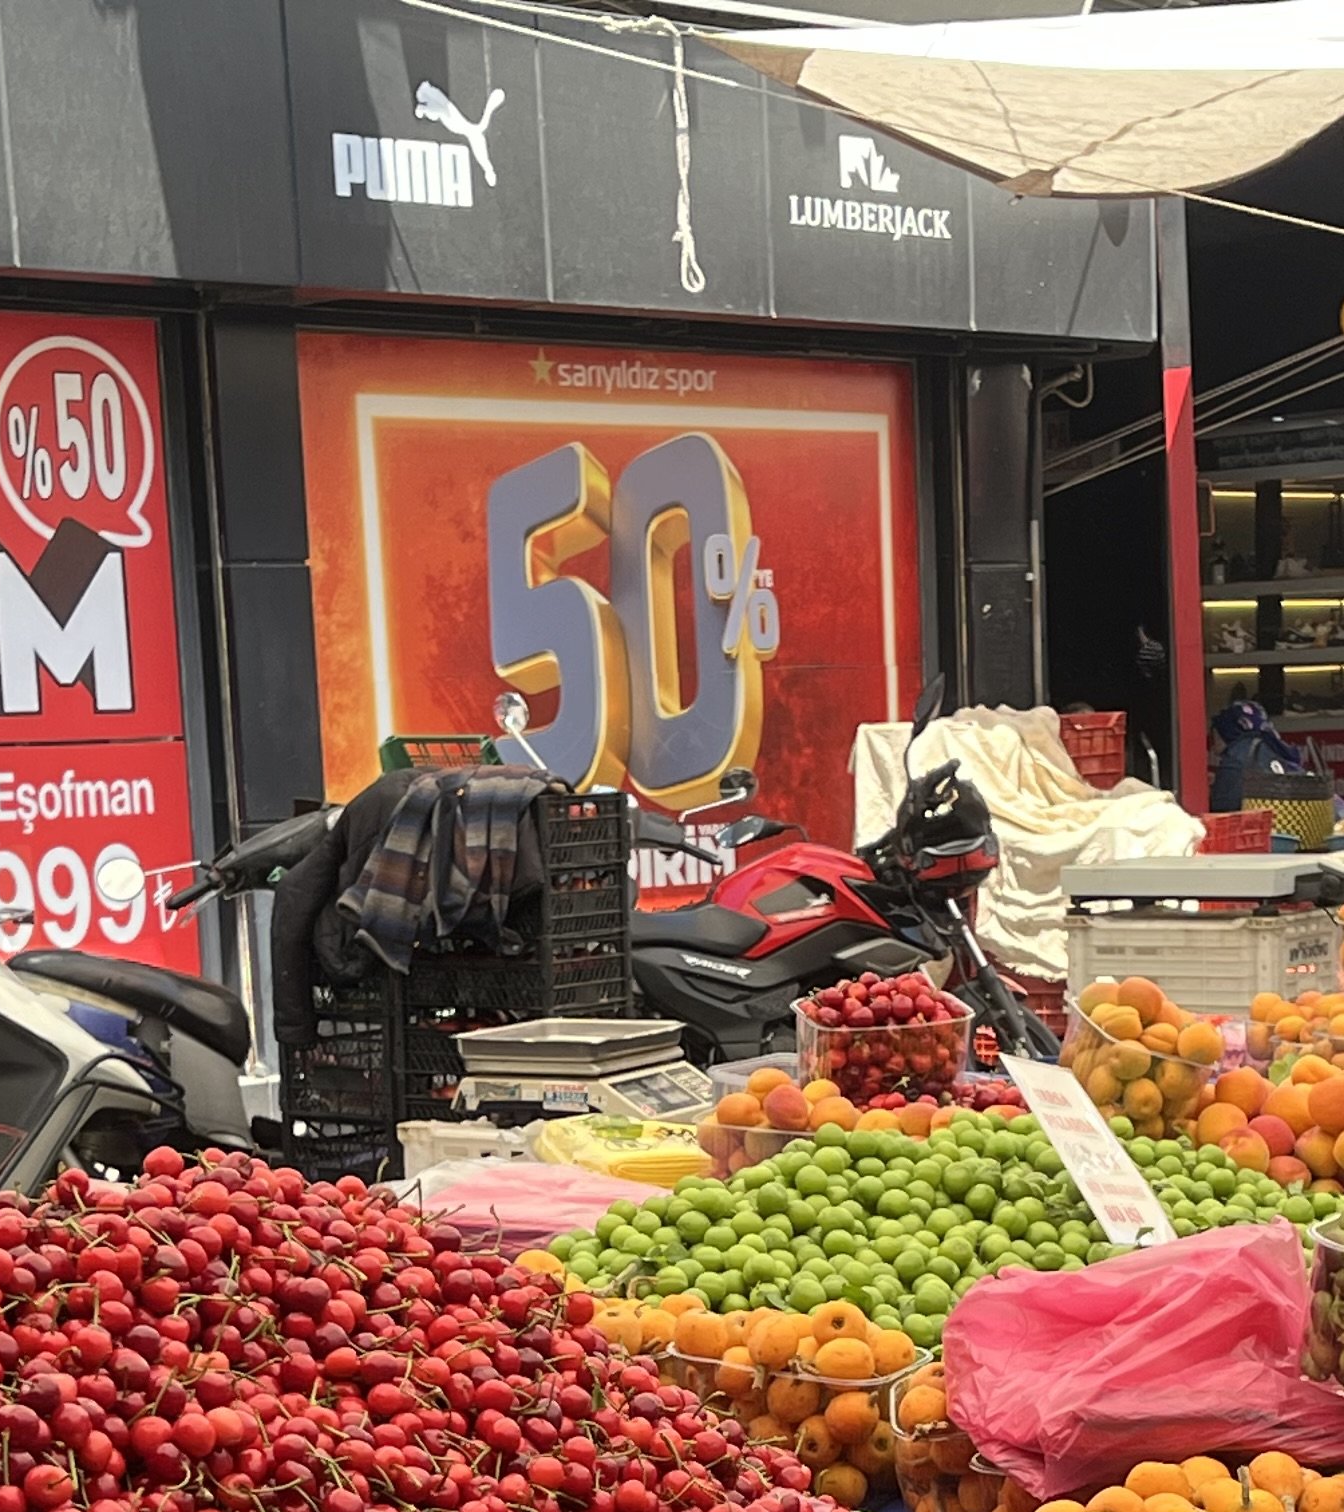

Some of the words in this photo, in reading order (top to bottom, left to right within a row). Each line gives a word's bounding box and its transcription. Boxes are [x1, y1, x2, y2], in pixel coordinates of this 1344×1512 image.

[332, 132, 473, 208] PUMA
[788, 194, 952, 241] LUMBERJACK
[665, 367, 717, 397] spor
[8, 372, 127, 501] %50
